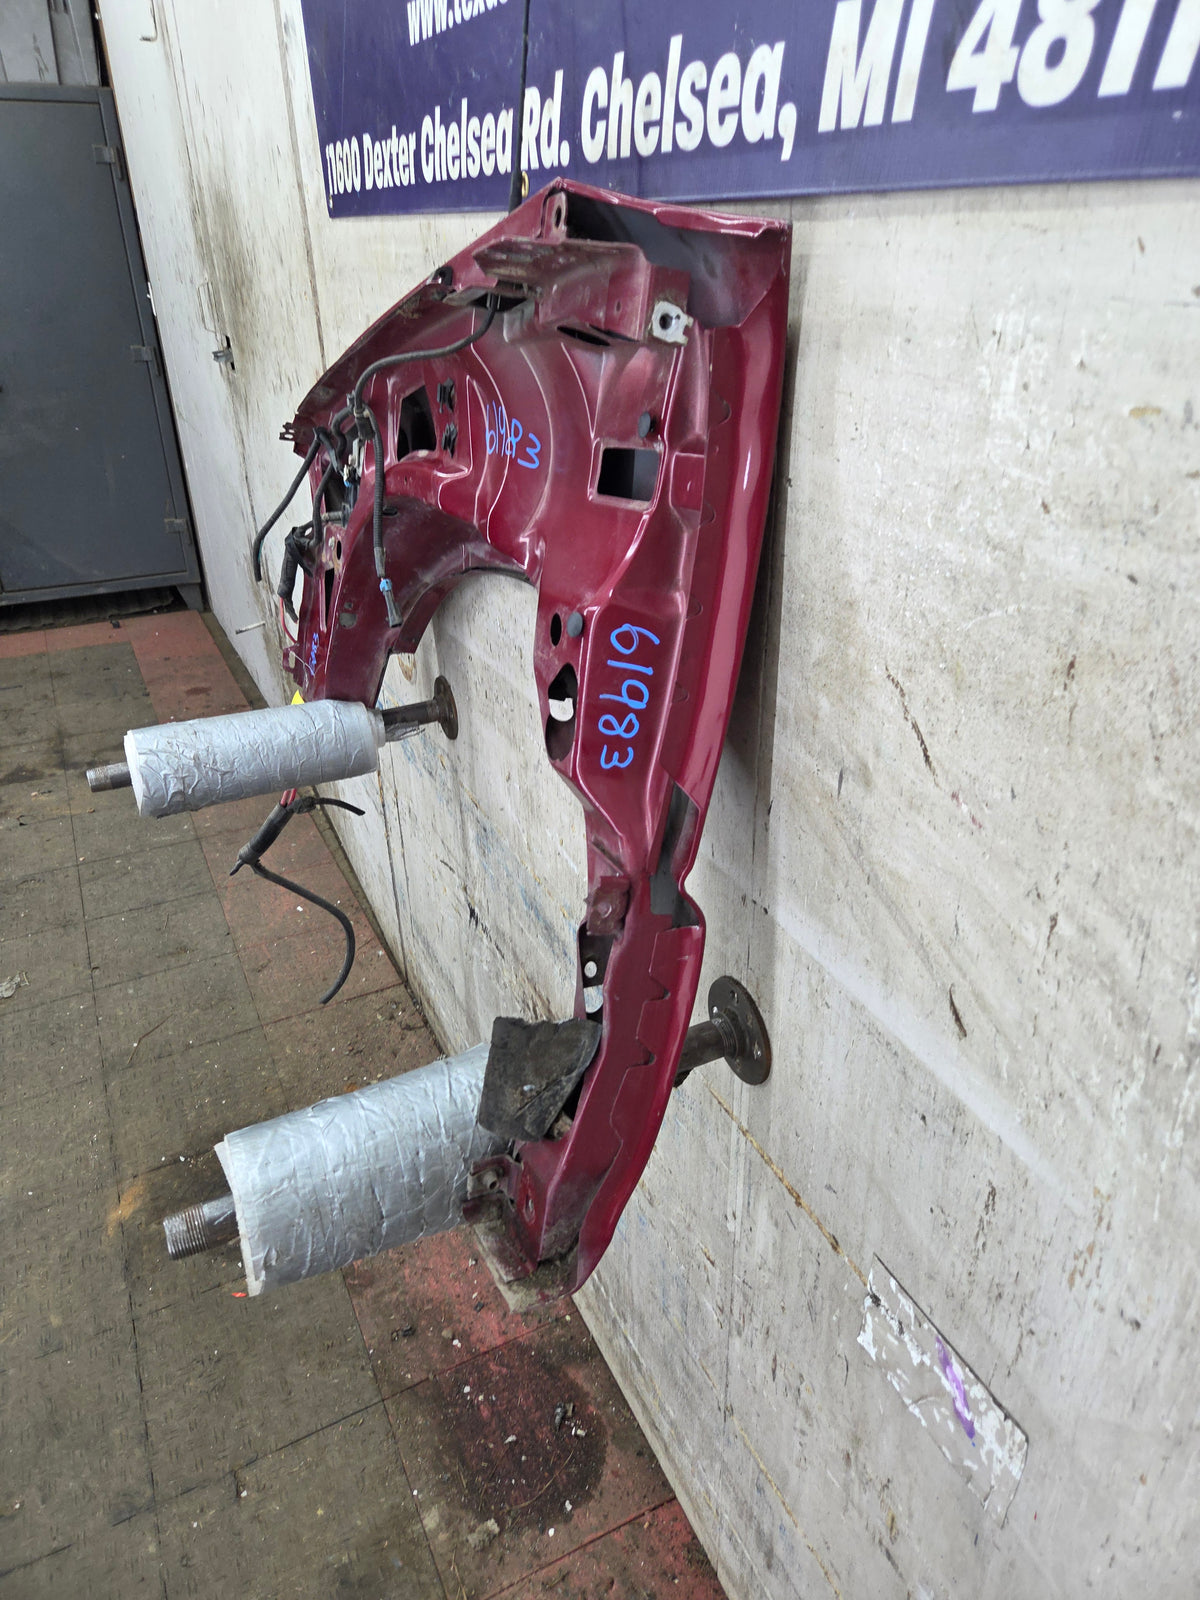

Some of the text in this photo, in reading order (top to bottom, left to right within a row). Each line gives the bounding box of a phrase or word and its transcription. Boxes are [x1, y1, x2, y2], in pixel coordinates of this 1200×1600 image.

[325, 136, 361, 195] 11600
[362, 125, 416, 190] Dexter
[421, 97, 513, 184] Chelsea
[521, 69, 570, 171] Rd.
[580, 33, 798, 163] Chelsea,
[818, 0, 935, 133] MI
[598, 623, 661, 770] 61983
